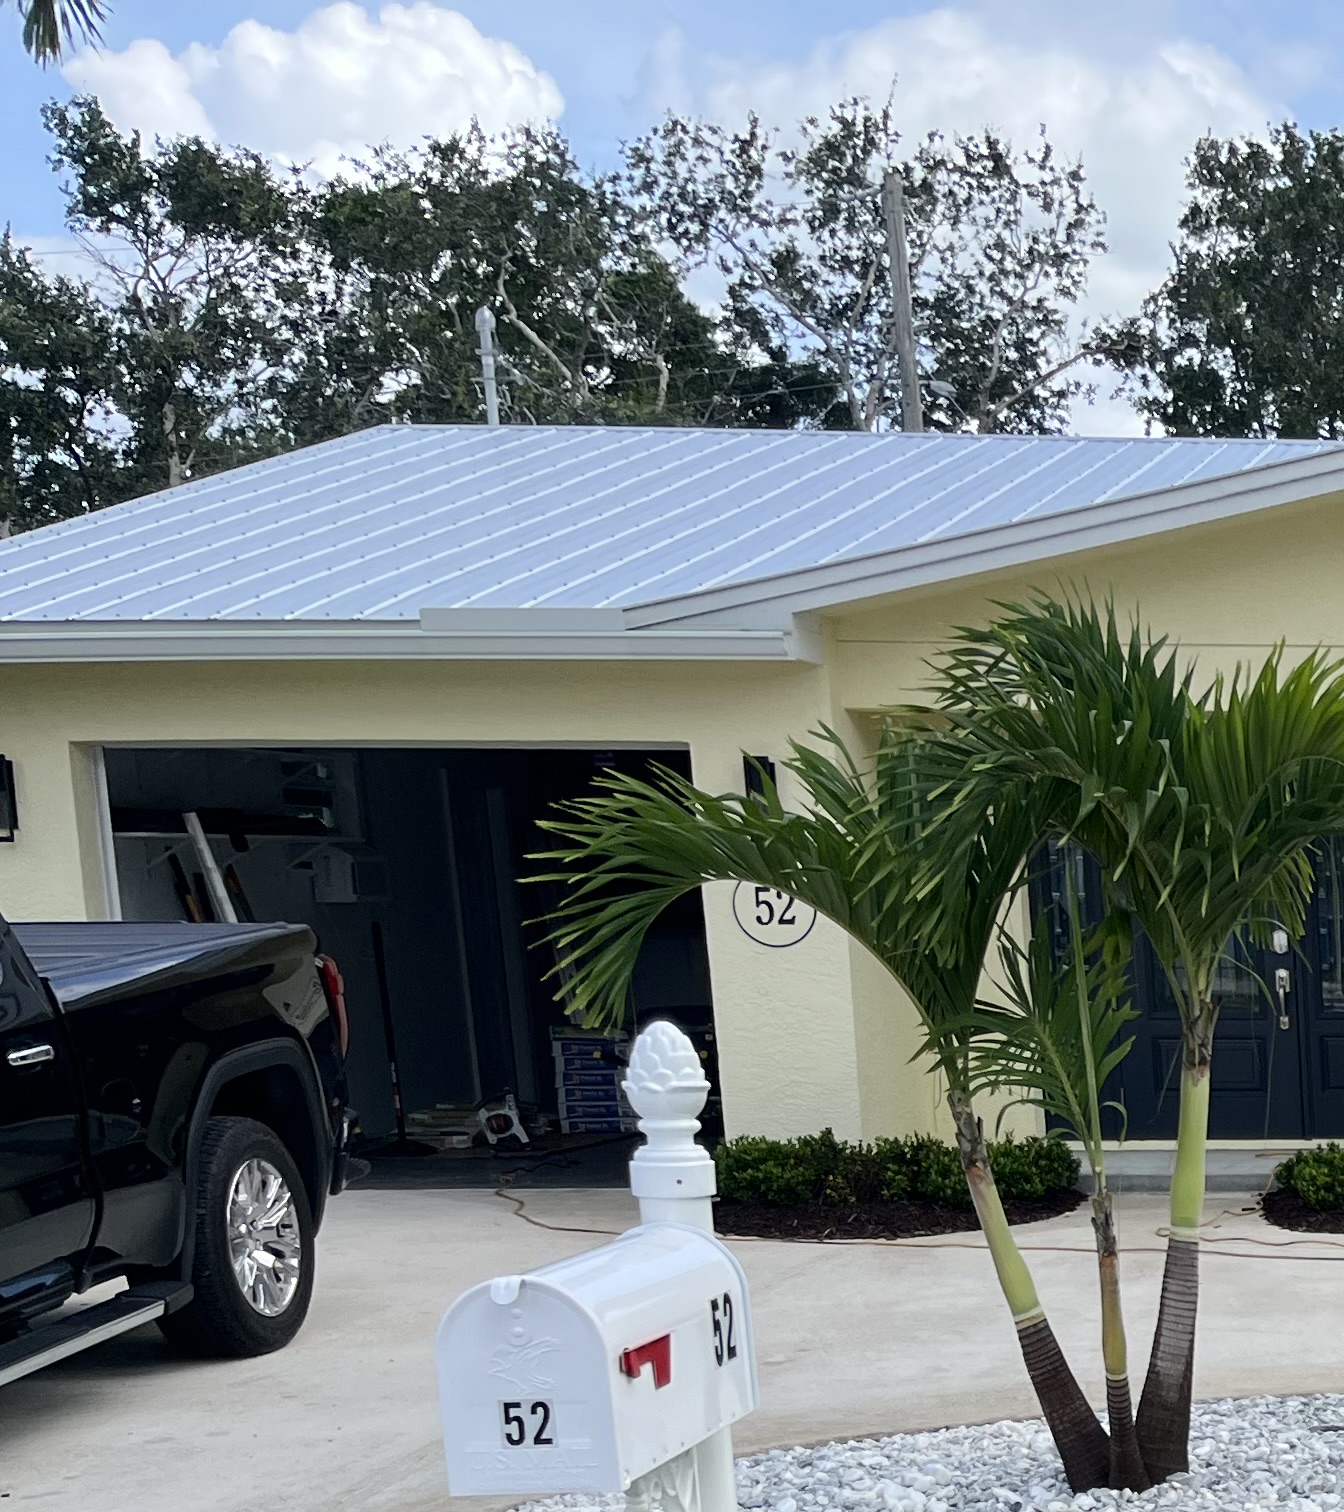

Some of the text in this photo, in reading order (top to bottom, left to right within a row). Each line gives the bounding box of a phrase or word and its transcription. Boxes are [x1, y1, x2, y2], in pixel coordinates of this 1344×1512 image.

[754, 886, 797, 925] 52
[711, 1291, 737, 1367] 52
[503, 1401, 554, 1446] 52
